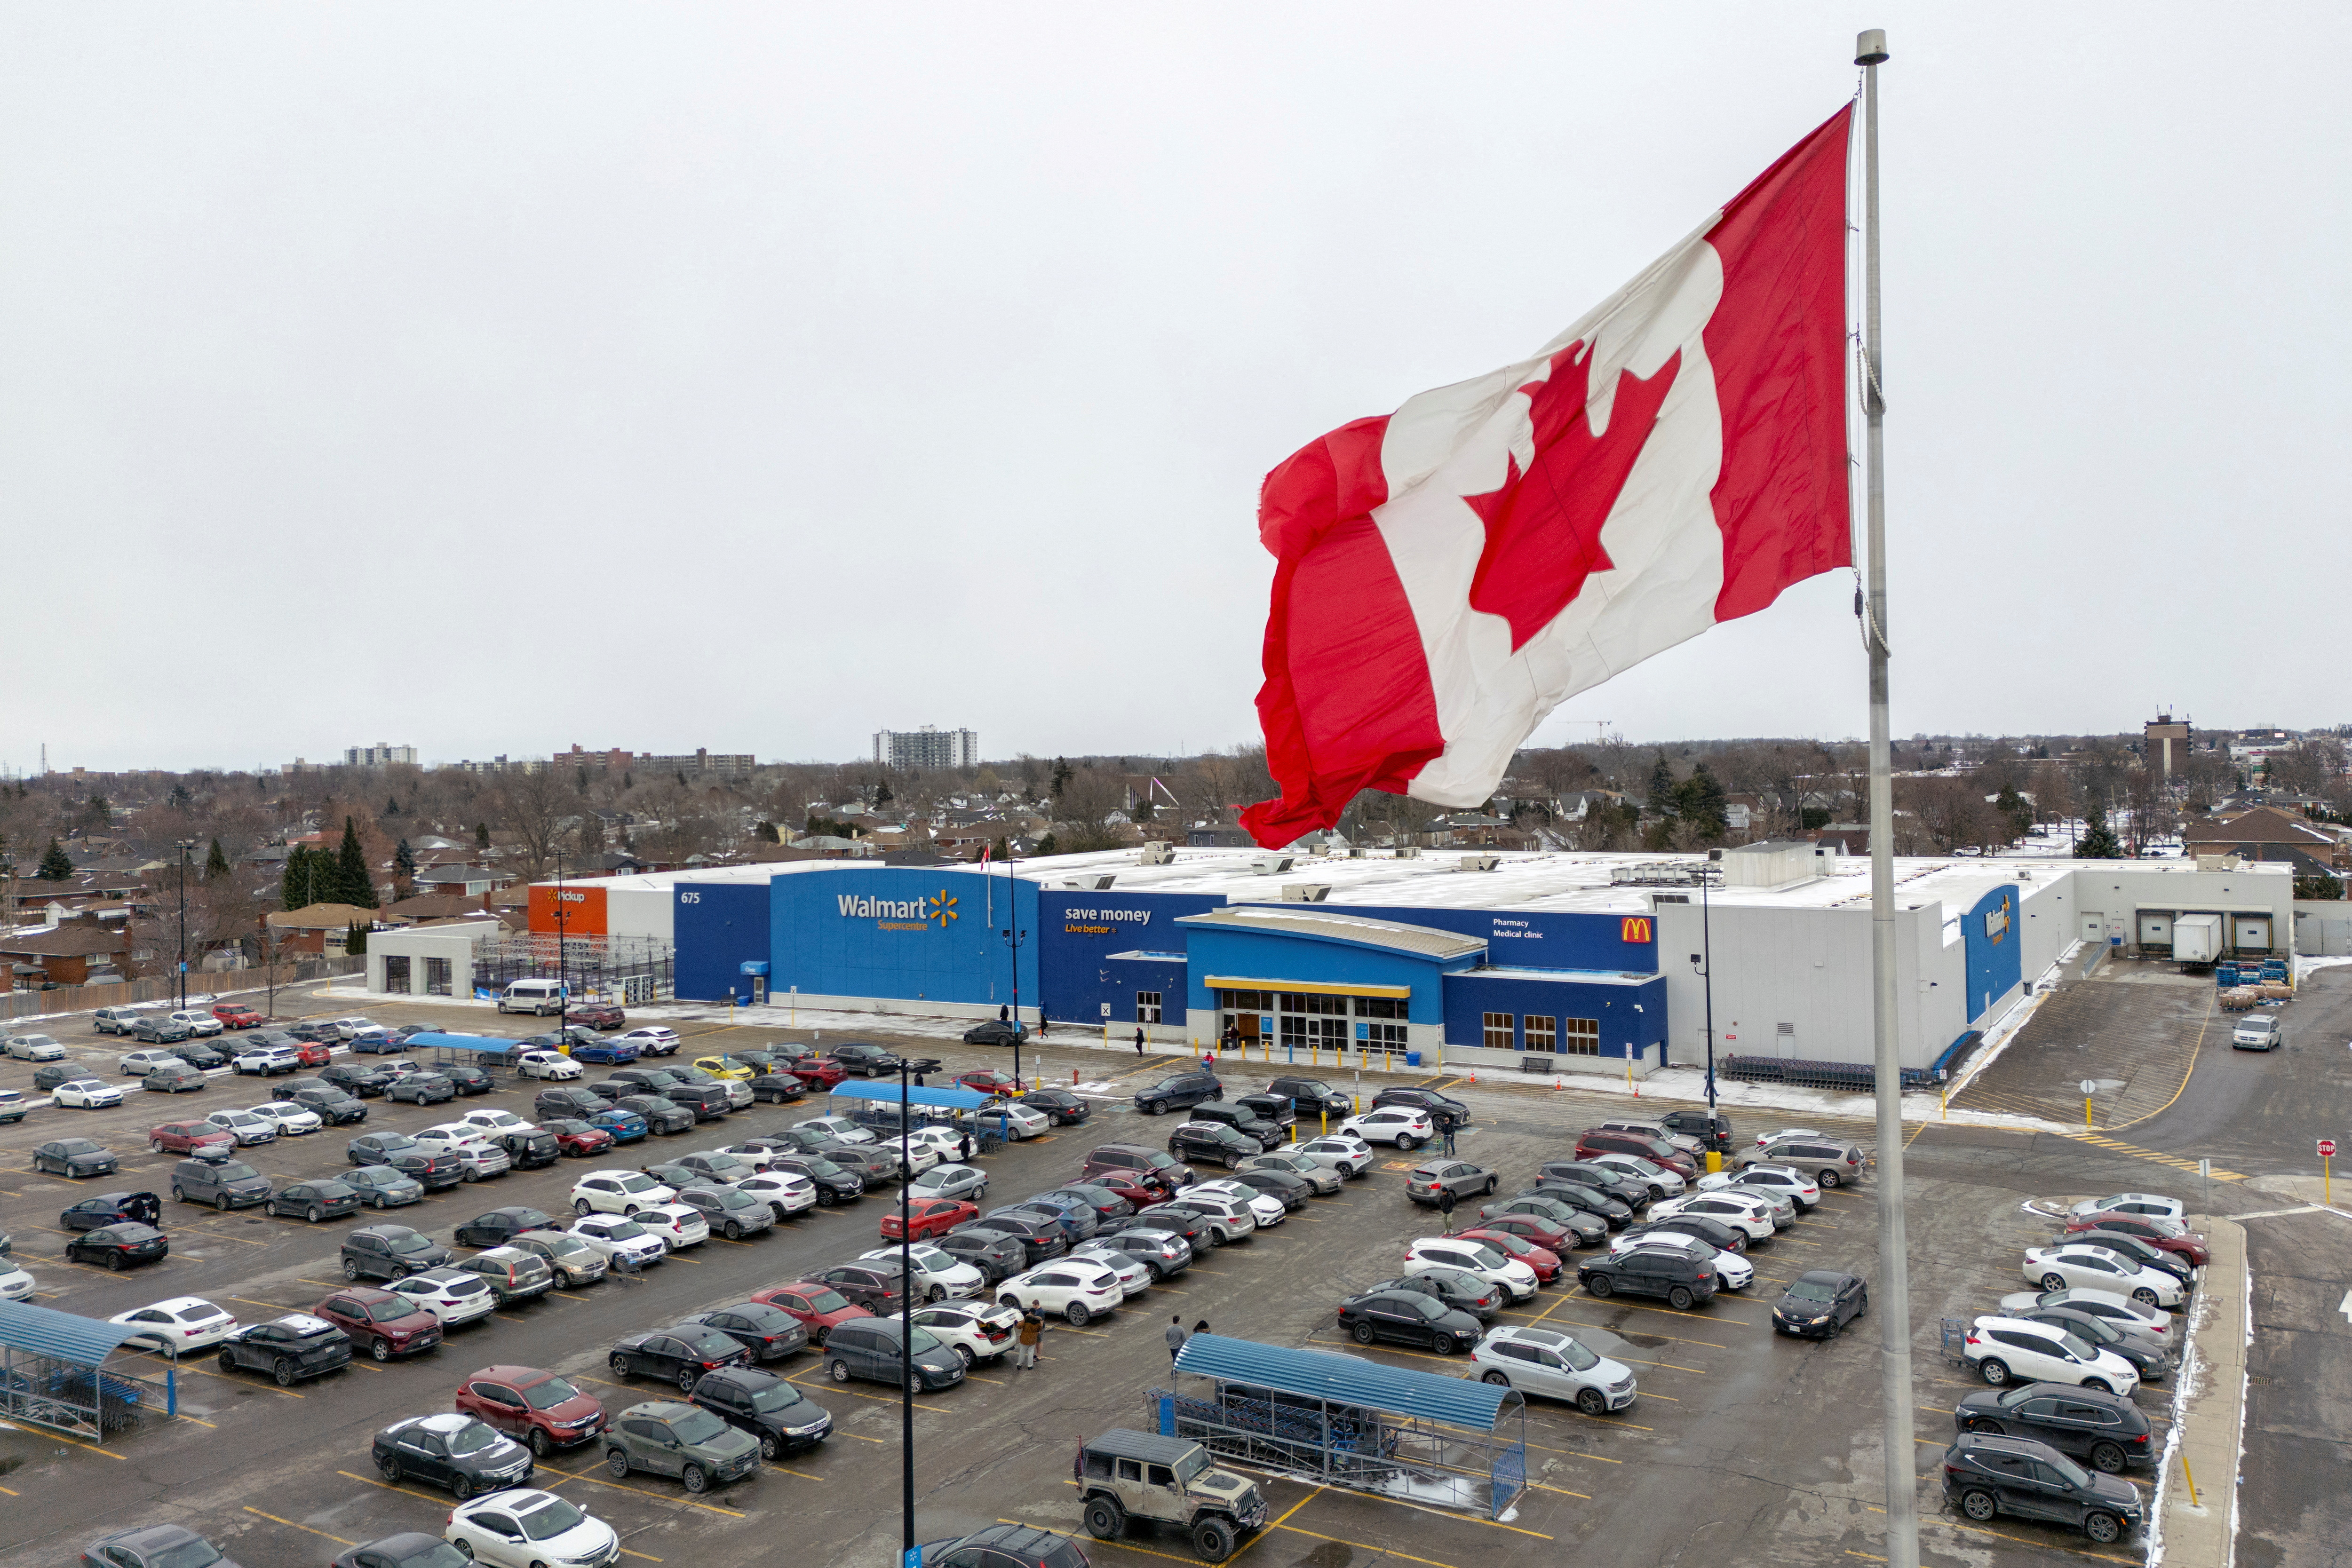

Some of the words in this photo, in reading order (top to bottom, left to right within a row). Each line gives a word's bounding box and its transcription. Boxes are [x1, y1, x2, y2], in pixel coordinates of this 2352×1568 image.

[557, 890, 585, 904] Pickup
[681, 892, 699, 903] 675
[837, 895, 927, 919] Walmart
[1065, 909, 1097, 920] save
[1101, 910, 1151, 926] money
[1494, 919, 1529, 928] Pharmacy
[878, 920, 928, 932] Supercentre
[1065, 924, 1084, 933] Live
[1083, 924, 1110, 934] better
